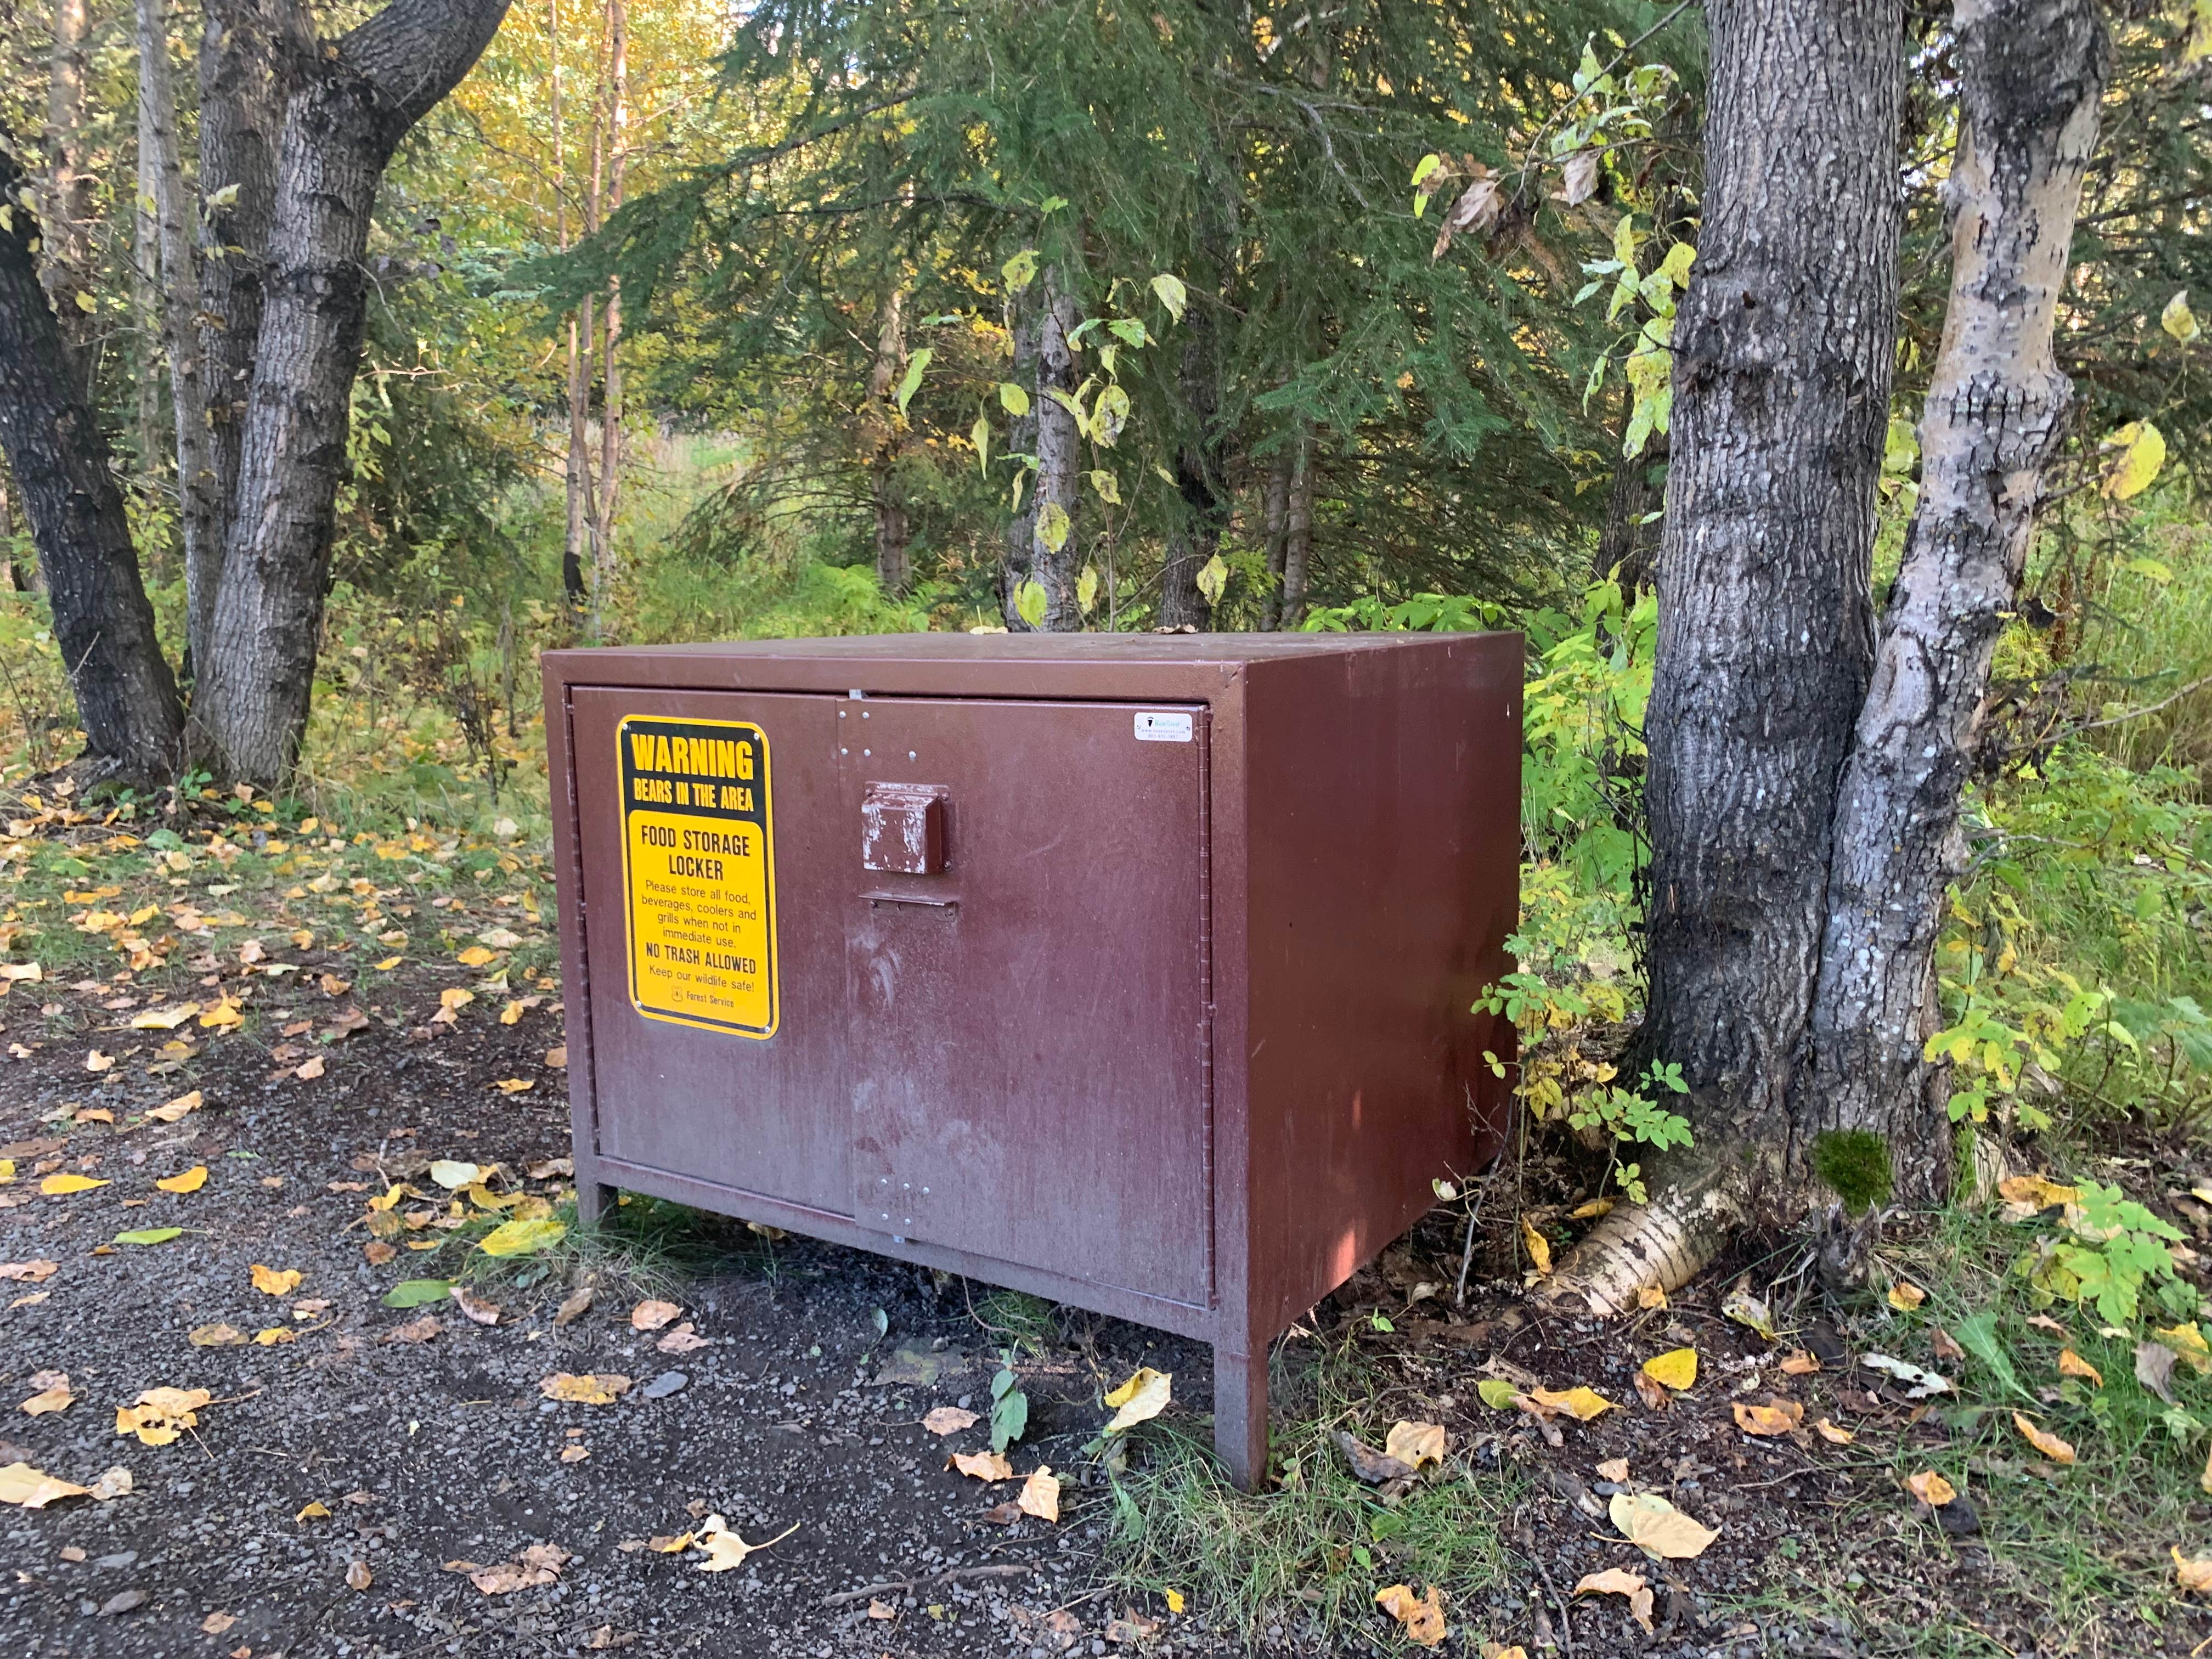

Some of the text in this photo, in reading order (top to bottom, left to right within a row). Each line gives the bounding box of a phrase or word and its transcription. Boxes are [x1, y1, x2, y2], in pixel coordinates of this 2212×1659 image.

[630, 733, 754, 780] WARNING
[634, 777, 754, 812] BEARS IN THE AREA
[641, 825, 751, 857] FOOD STORAGE
[669, 854, 724, 881] LOCKER
[646, 879, 751, 905] Please store all food,
[641, 894, 757, 921] beverages, coolers and
[658, 912, 741, 934] grills when not in
[663, 927, 736, 948] immediate use.
[646, 942, 757, 974] NO TRASH ALLOWED
[649, 964, 754, 992] Keep our wildlife safe!
[686, 991, 735, 1008] Forest Service
